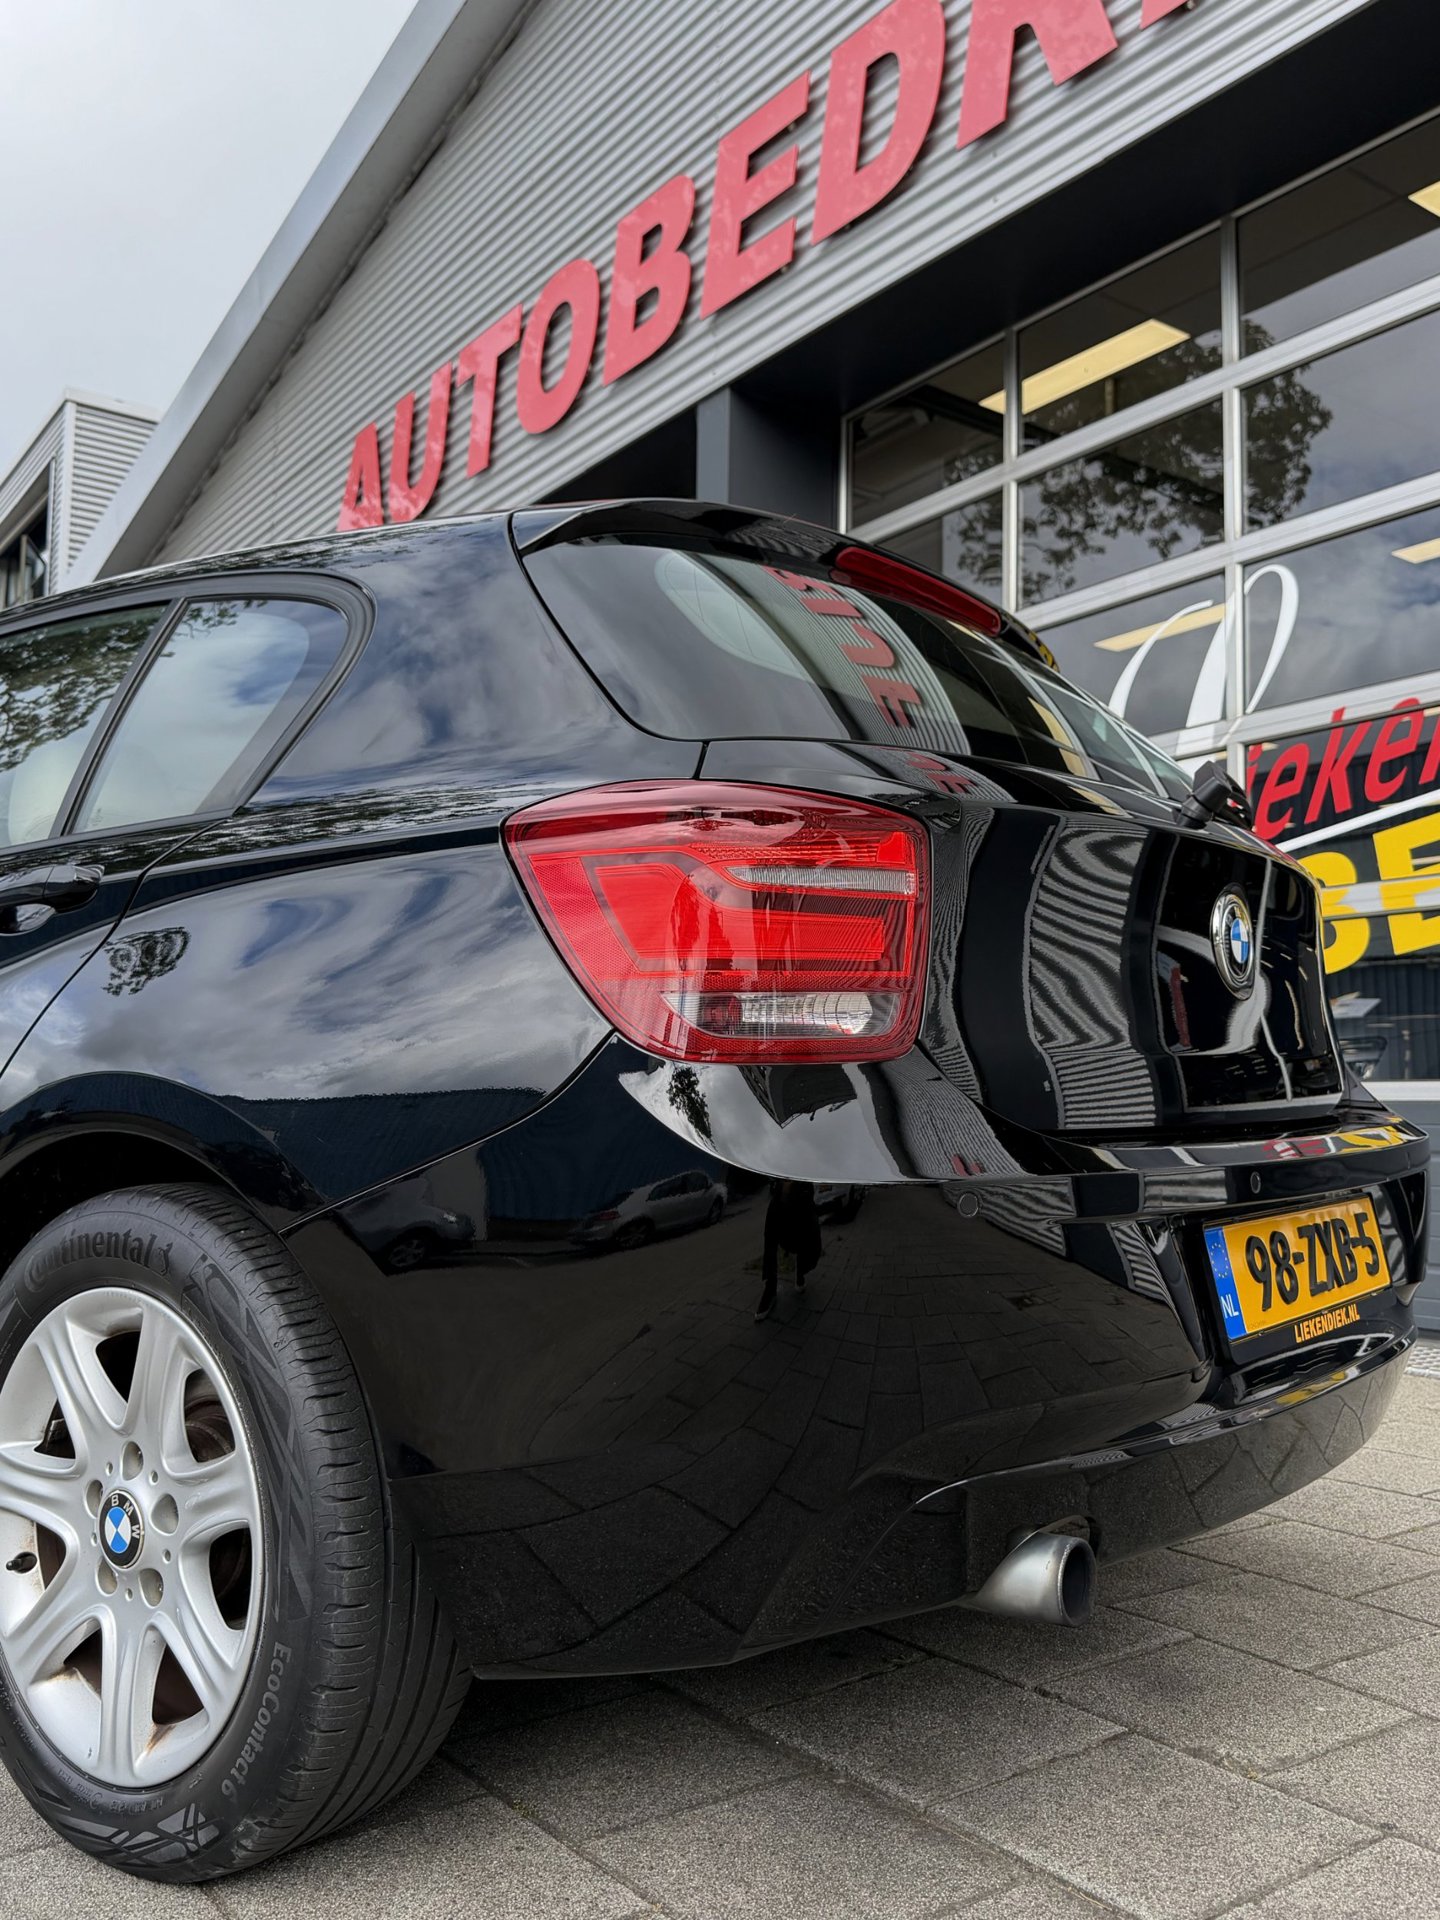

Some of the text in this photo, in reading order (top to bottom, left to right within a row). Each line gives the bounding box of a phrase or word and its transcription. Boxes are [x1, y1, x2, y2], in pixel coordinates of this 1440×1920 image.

[25, 1228, 158, 1293] Continental
[1245, 1212, 1380, 1312] 98-ZXB-5
[1220, 1294, 1239, 1319] NL
[1294, 1303, 1361, 1343] LIEKENDIEK.NL
[111, 1494, 140, 1539] BMW
[221, 1641, 292, 1804] EcoContact 6
